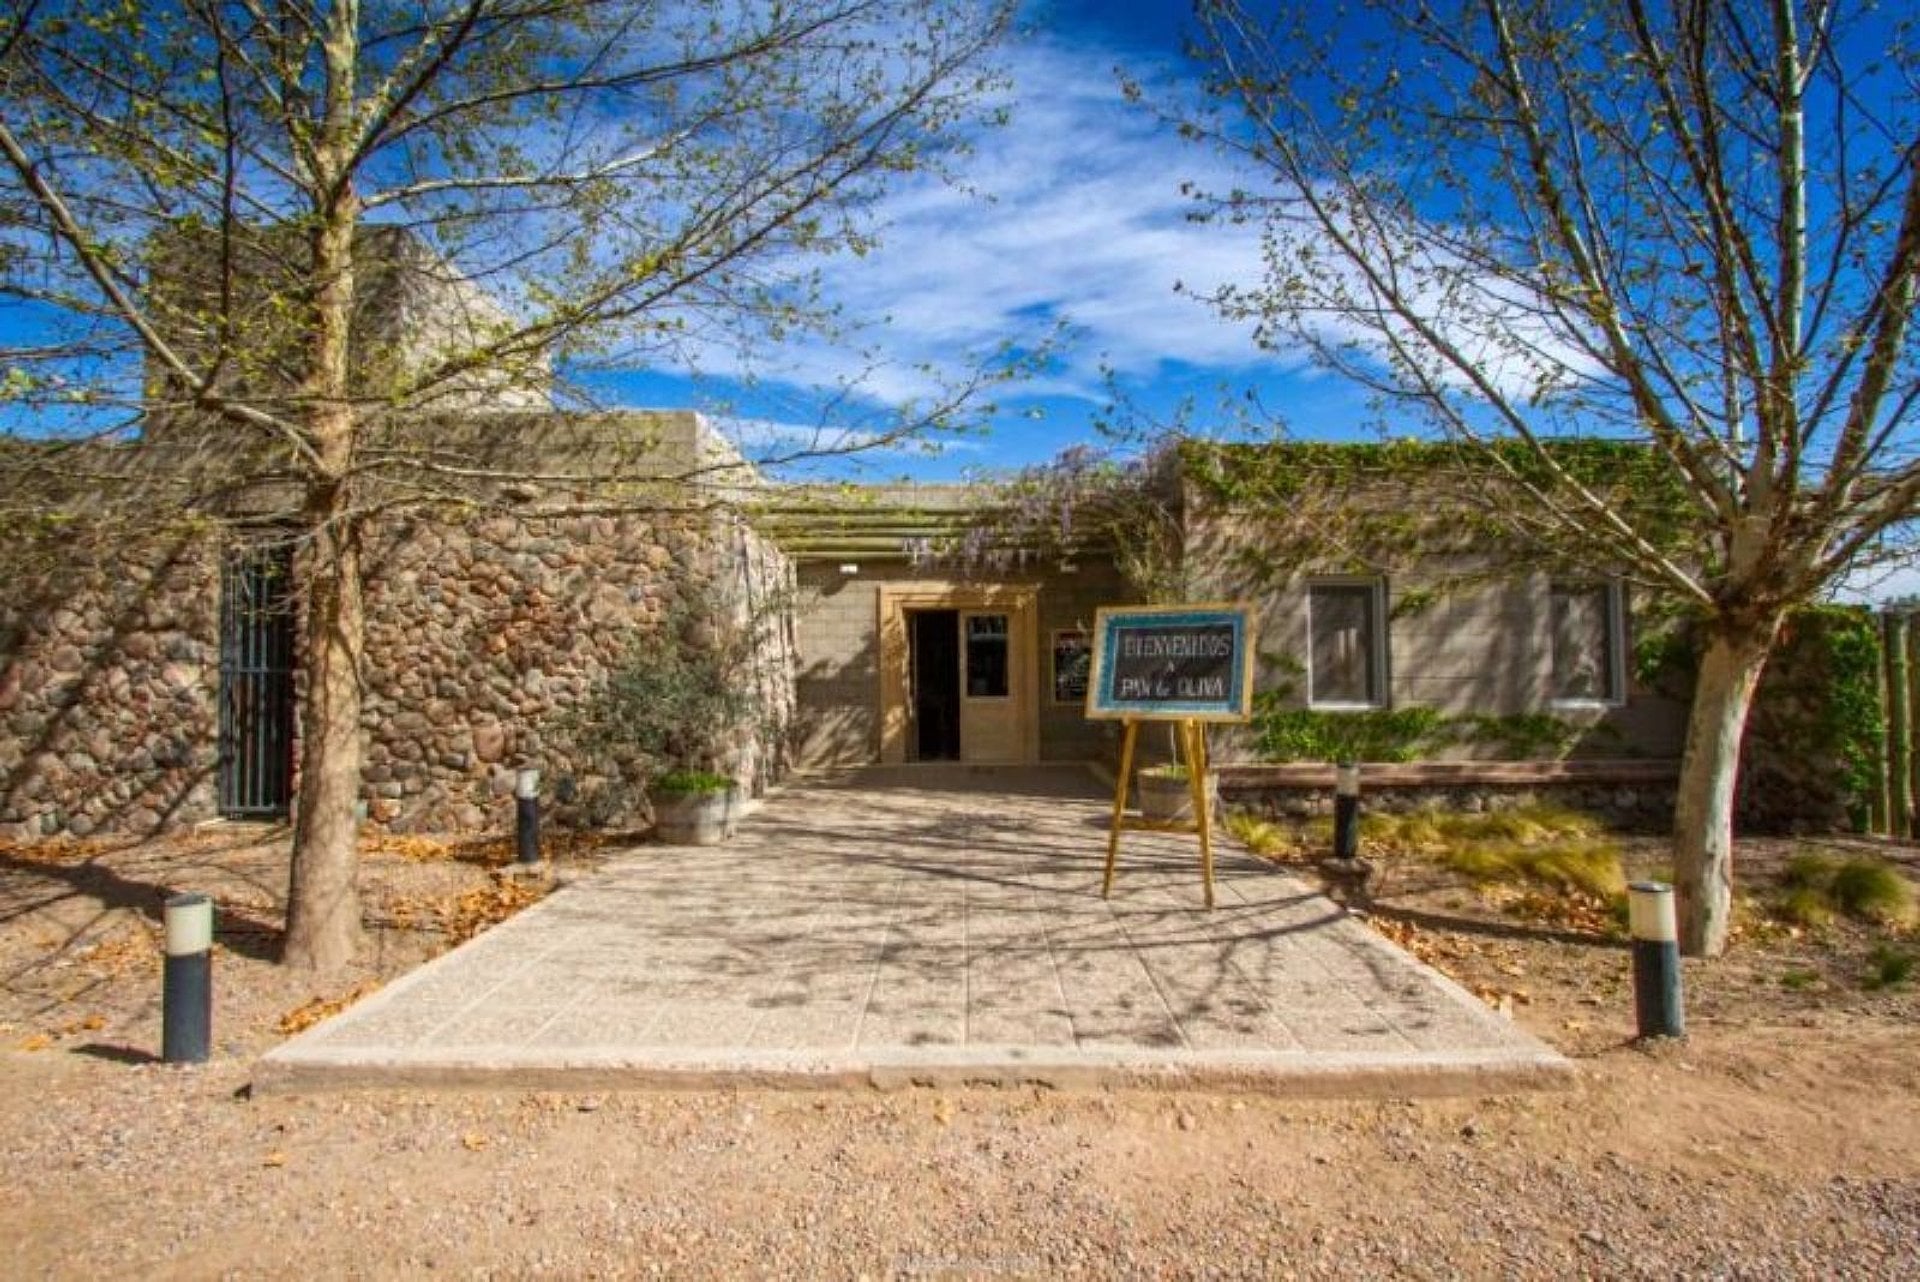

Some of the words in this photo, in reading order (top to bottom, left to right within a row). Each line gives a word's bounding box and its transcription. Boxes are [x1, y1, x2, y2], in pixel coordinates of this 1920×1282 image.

[1125, 634, 1230, 656] BIENVENIDOS
[1121, 676, 1150, 696] PAN
[1177, 676, 1224, 696] OLIVA
